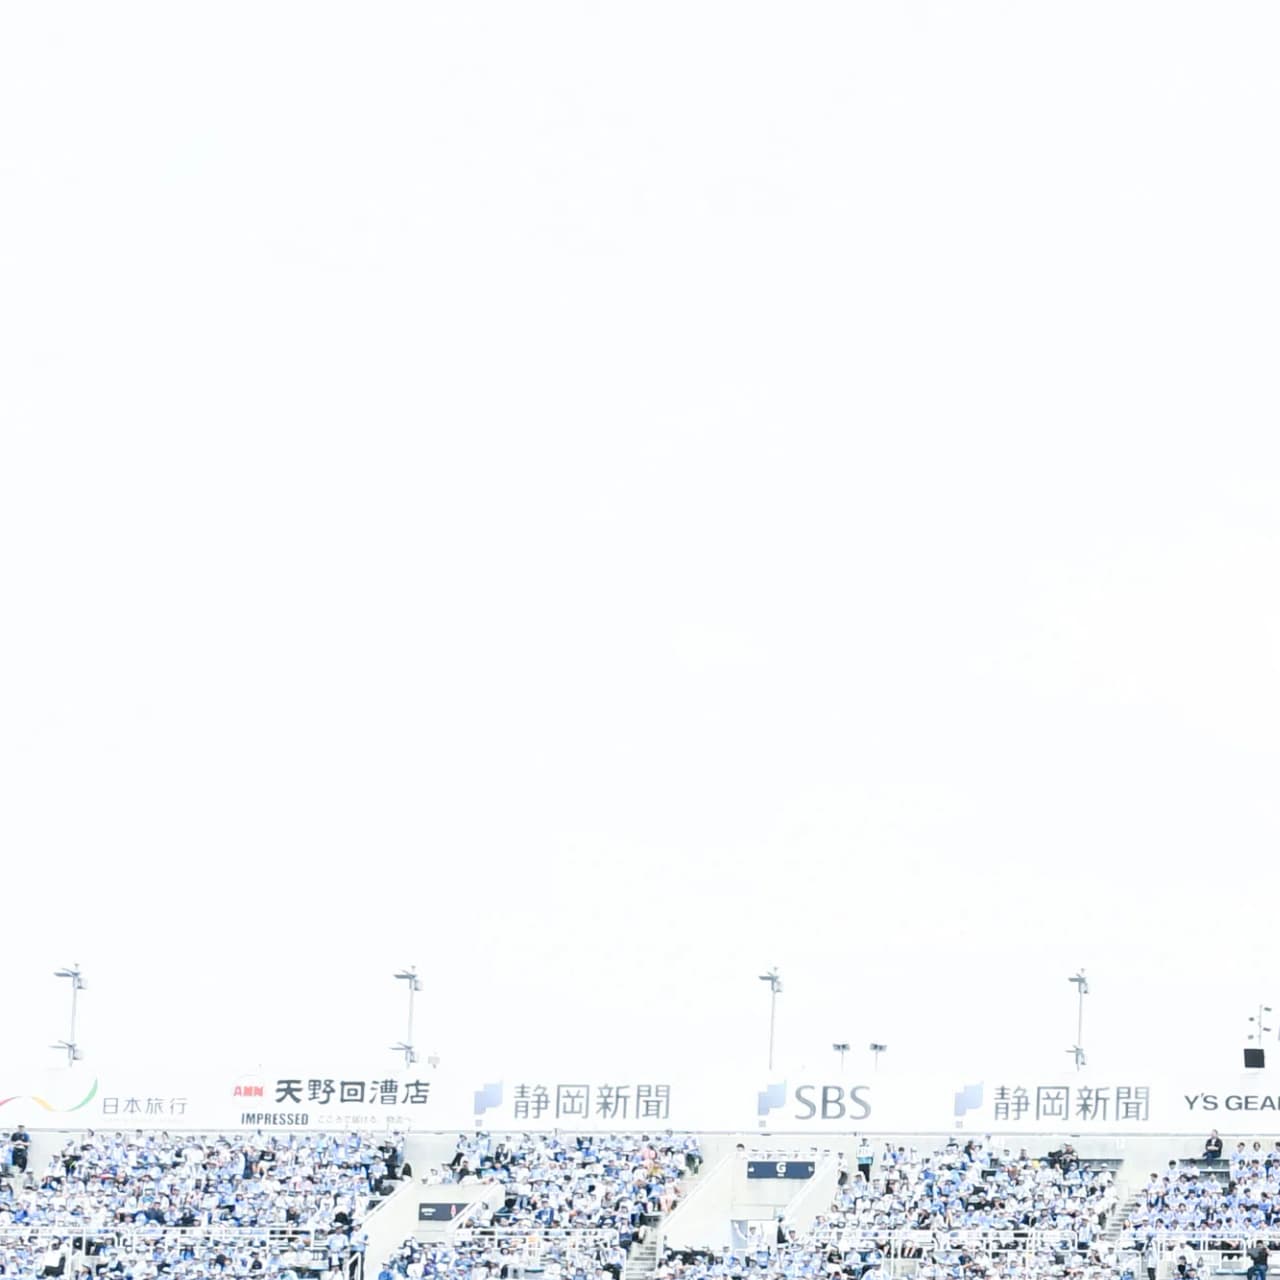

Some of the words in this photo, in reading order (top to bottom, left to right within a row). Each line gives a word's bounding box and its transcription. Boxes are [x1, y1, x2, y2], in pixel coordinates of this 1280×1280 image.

[275, 1079, 430, 1105] 天野回漕店
[514, 1084, 671, 1120] 静岡新聞
[794, 1085, 872, 1120] SBS
[1184, 1093, 1218, 1111] Y'S
[103, 1097, 187, 1115] 日本旅行
[994, 1086, 1151, 1121] 静岡新聞
[241, 1113, 309, 1125] IMPRESSED
[776, 1163, 786, 1172] G
